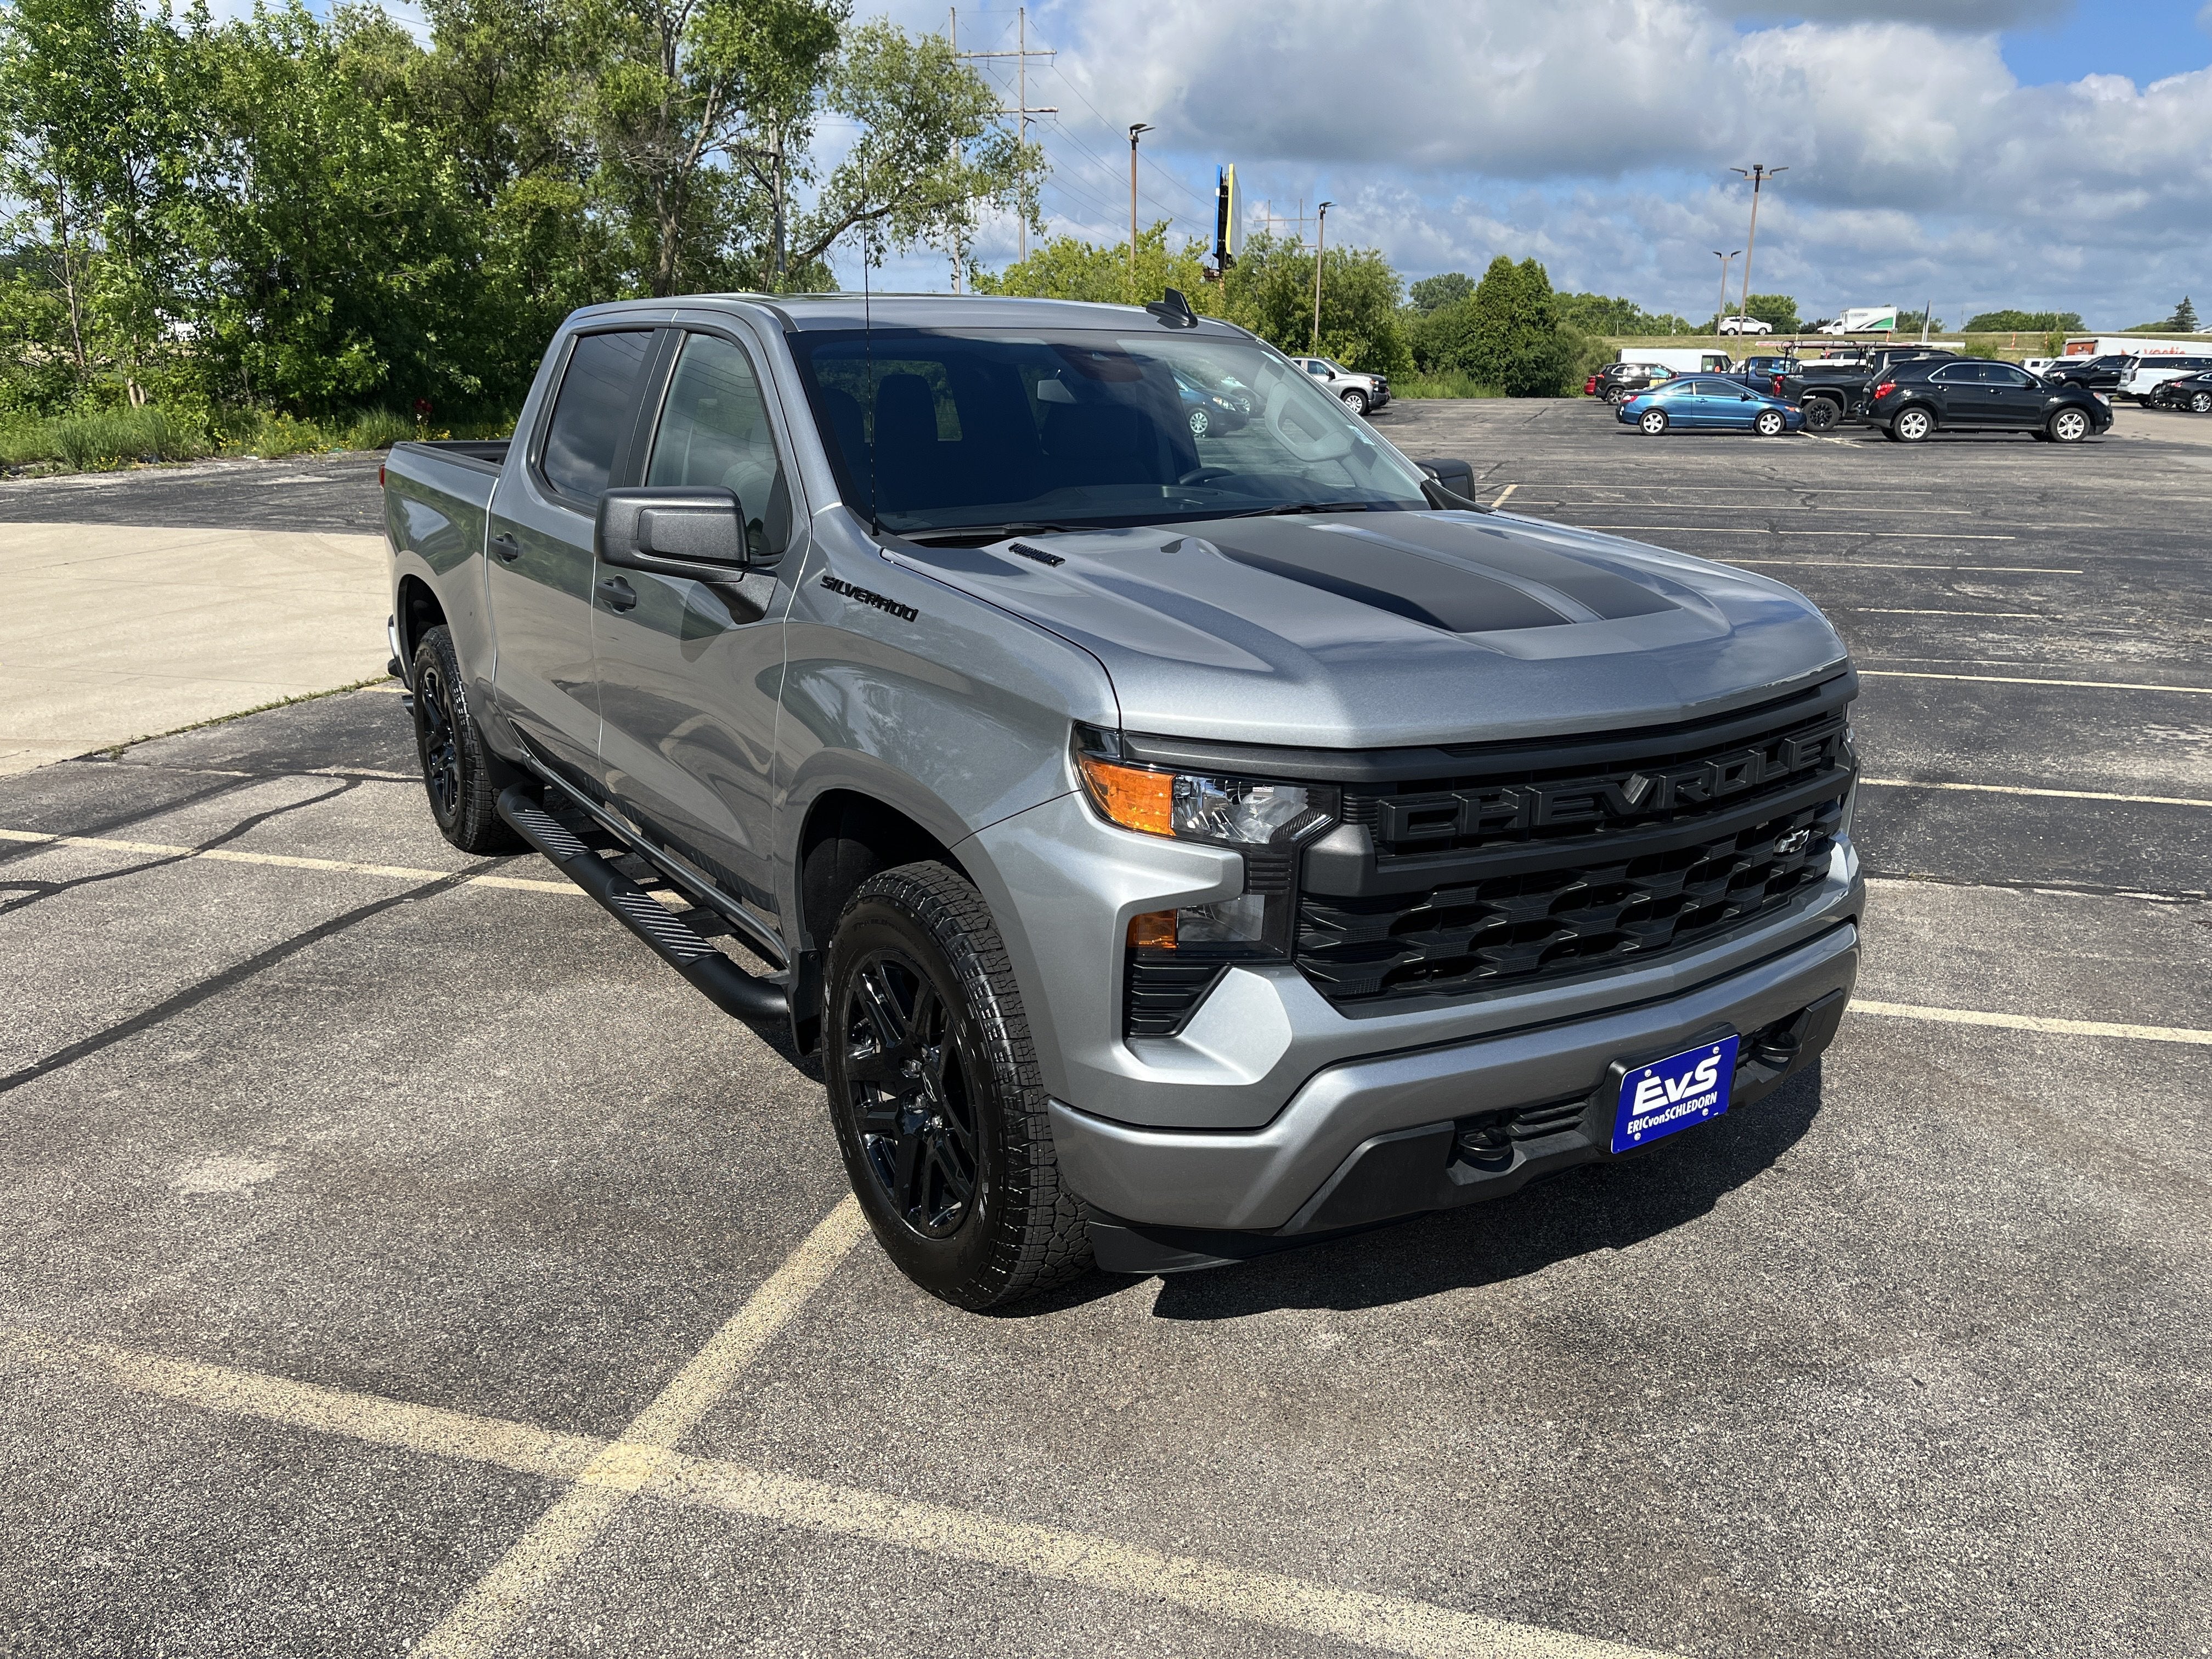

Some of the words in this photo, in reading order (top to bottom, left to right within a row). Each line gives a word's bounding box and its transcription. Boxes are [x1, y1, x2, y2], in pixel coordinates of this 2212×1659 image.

[820, 575, 919, 622] SILVERADO
[1376, 720, 1849, 842] CHEVROLET
[1627, 1091, 1718, 1135] ERICvonSCHLEDORN
